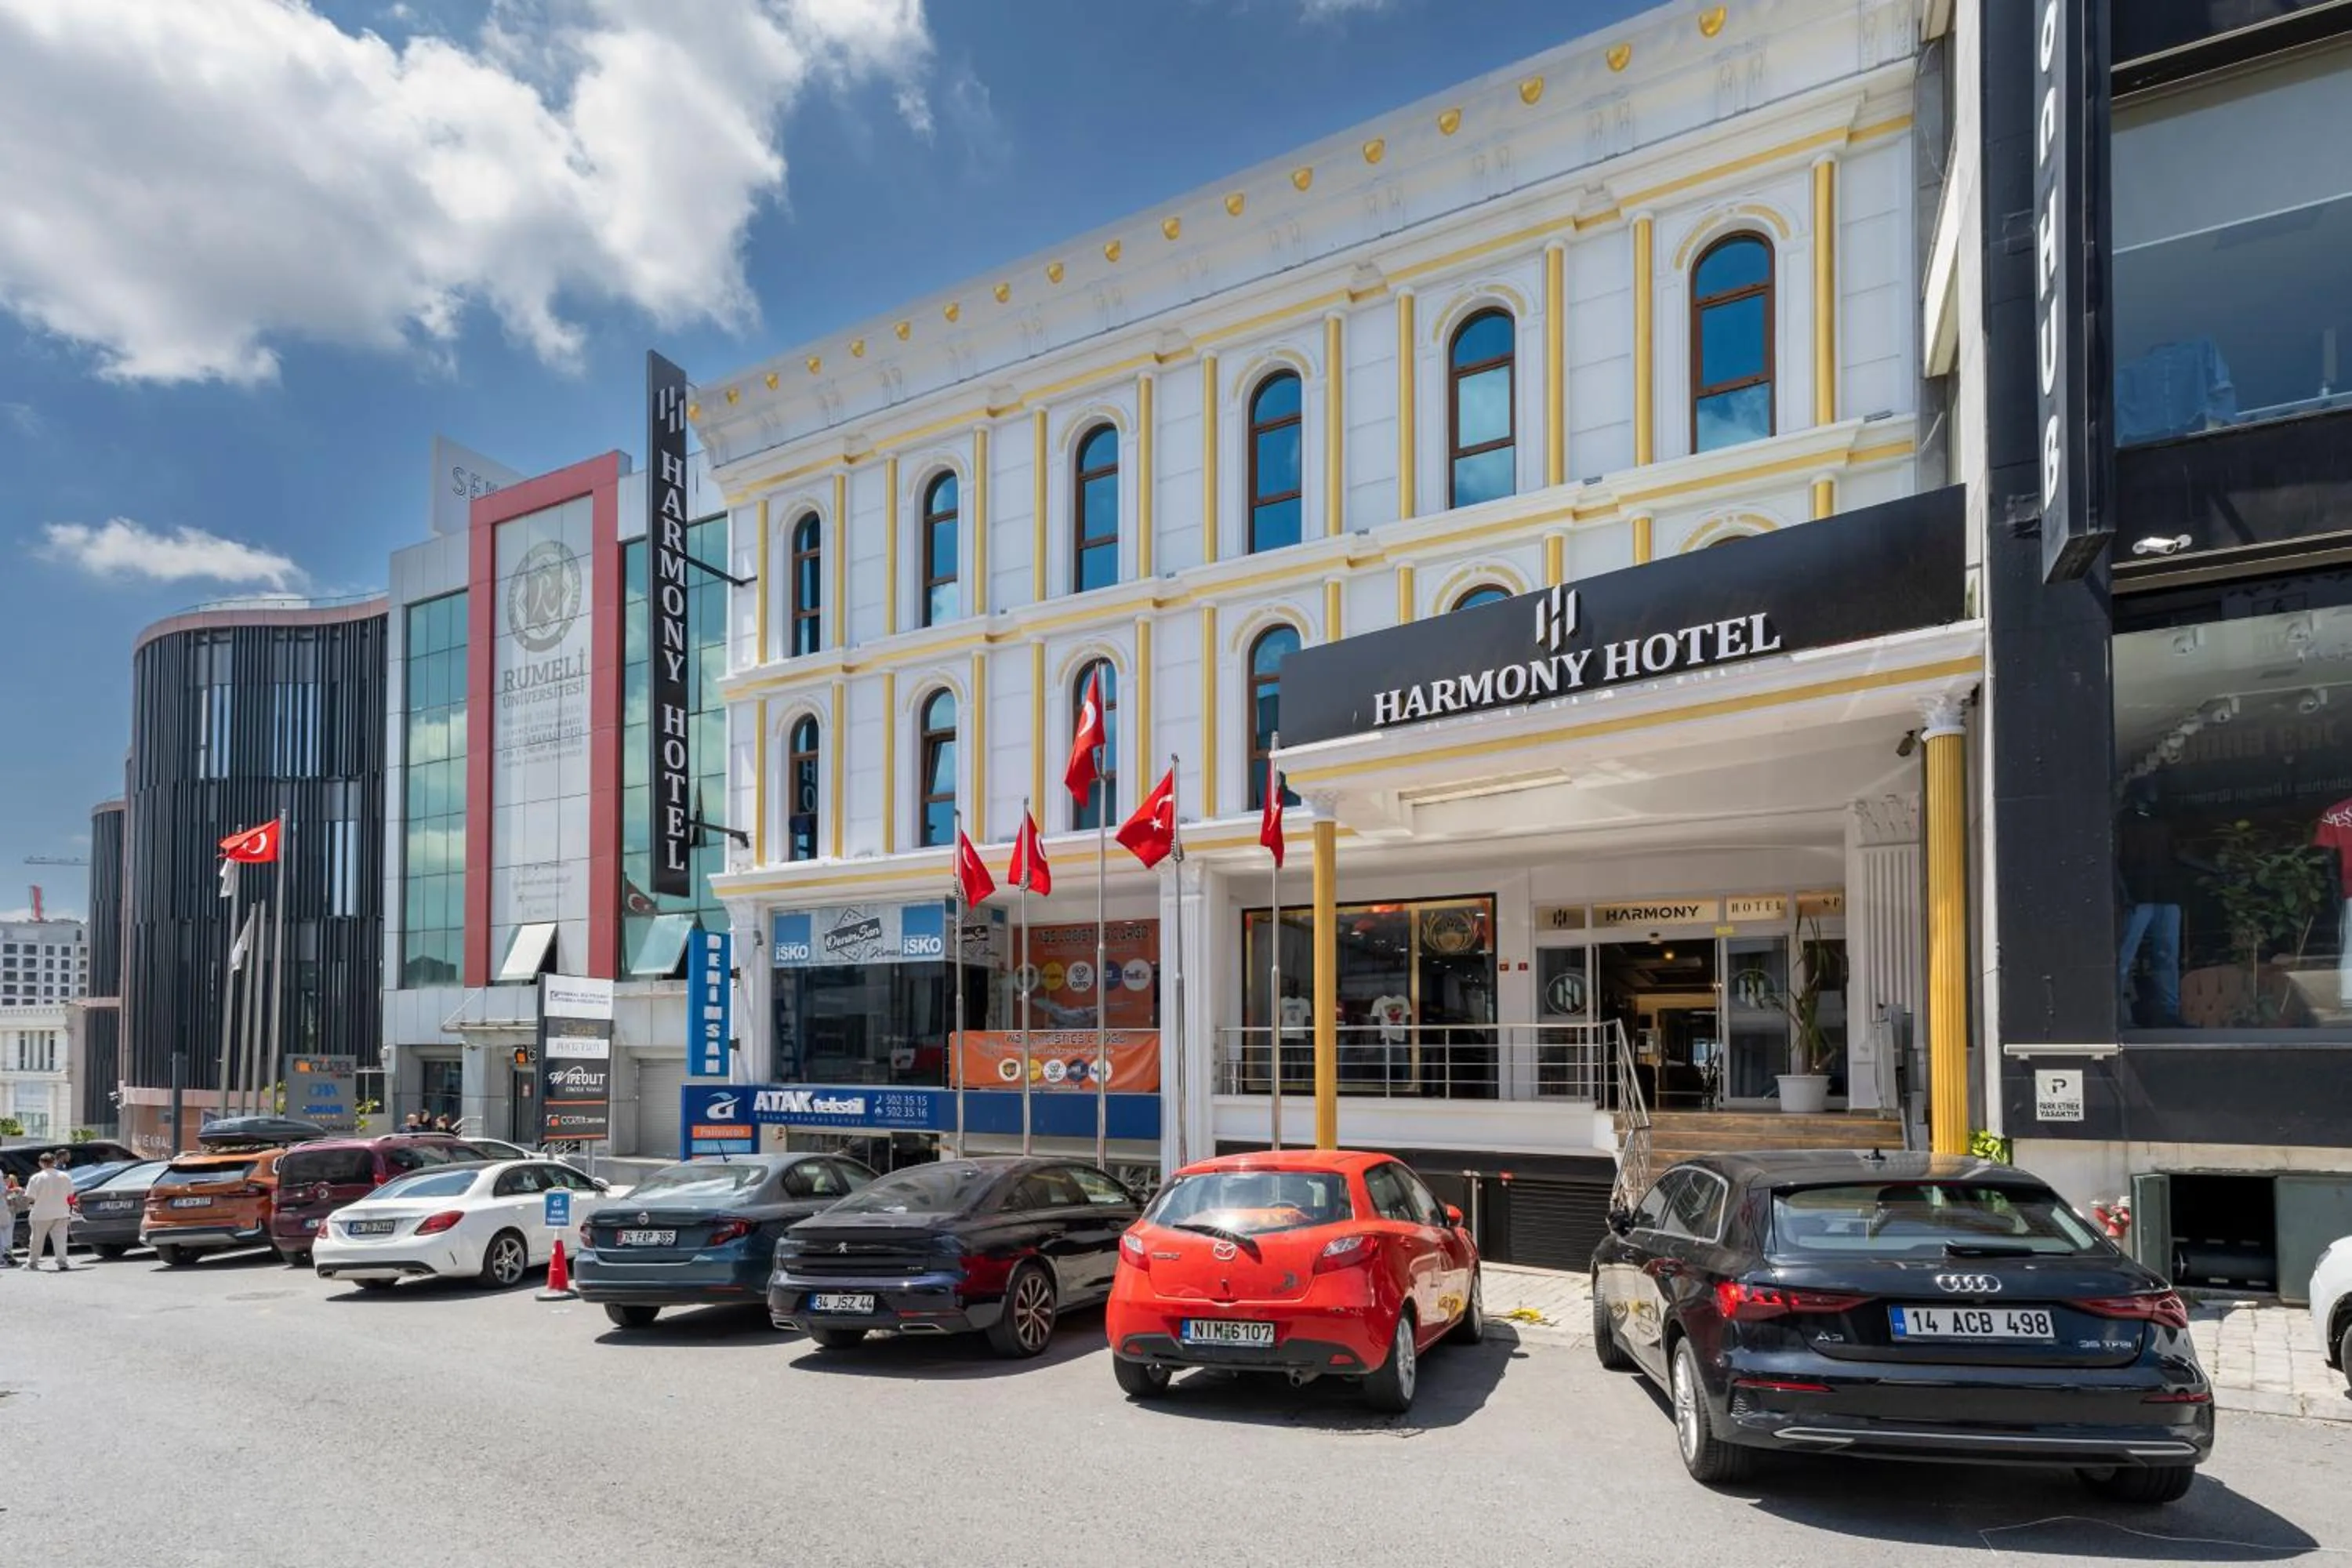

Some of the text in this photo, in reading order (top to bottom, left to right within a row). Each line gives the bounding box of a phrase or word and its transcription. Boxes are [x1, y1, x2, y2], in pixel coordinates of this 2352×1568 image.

[659, 447, 686, 871] HARMONY HOTEL
[1374, 612, 1780, 726] HARMONY HOTEL
[502, 646, 586, 693] RUMELİ
[1606, 906, 1699, 921] HARMONY
[1731, 901, 1781, 913] HOTEL
[753, 1091, 814, 1112] ATAK
[917, 1095, 927, 1105] 15
[816, 1296, 873, 1308] 34 JSZ 44
[1194, 1322, 1271, 1341] NIM 6107
[1913, 1311, 1939, 1332] 14
[1953, 1312, 1994, 1334] ACB
[2006, 1312, 2050, 1335] 498
